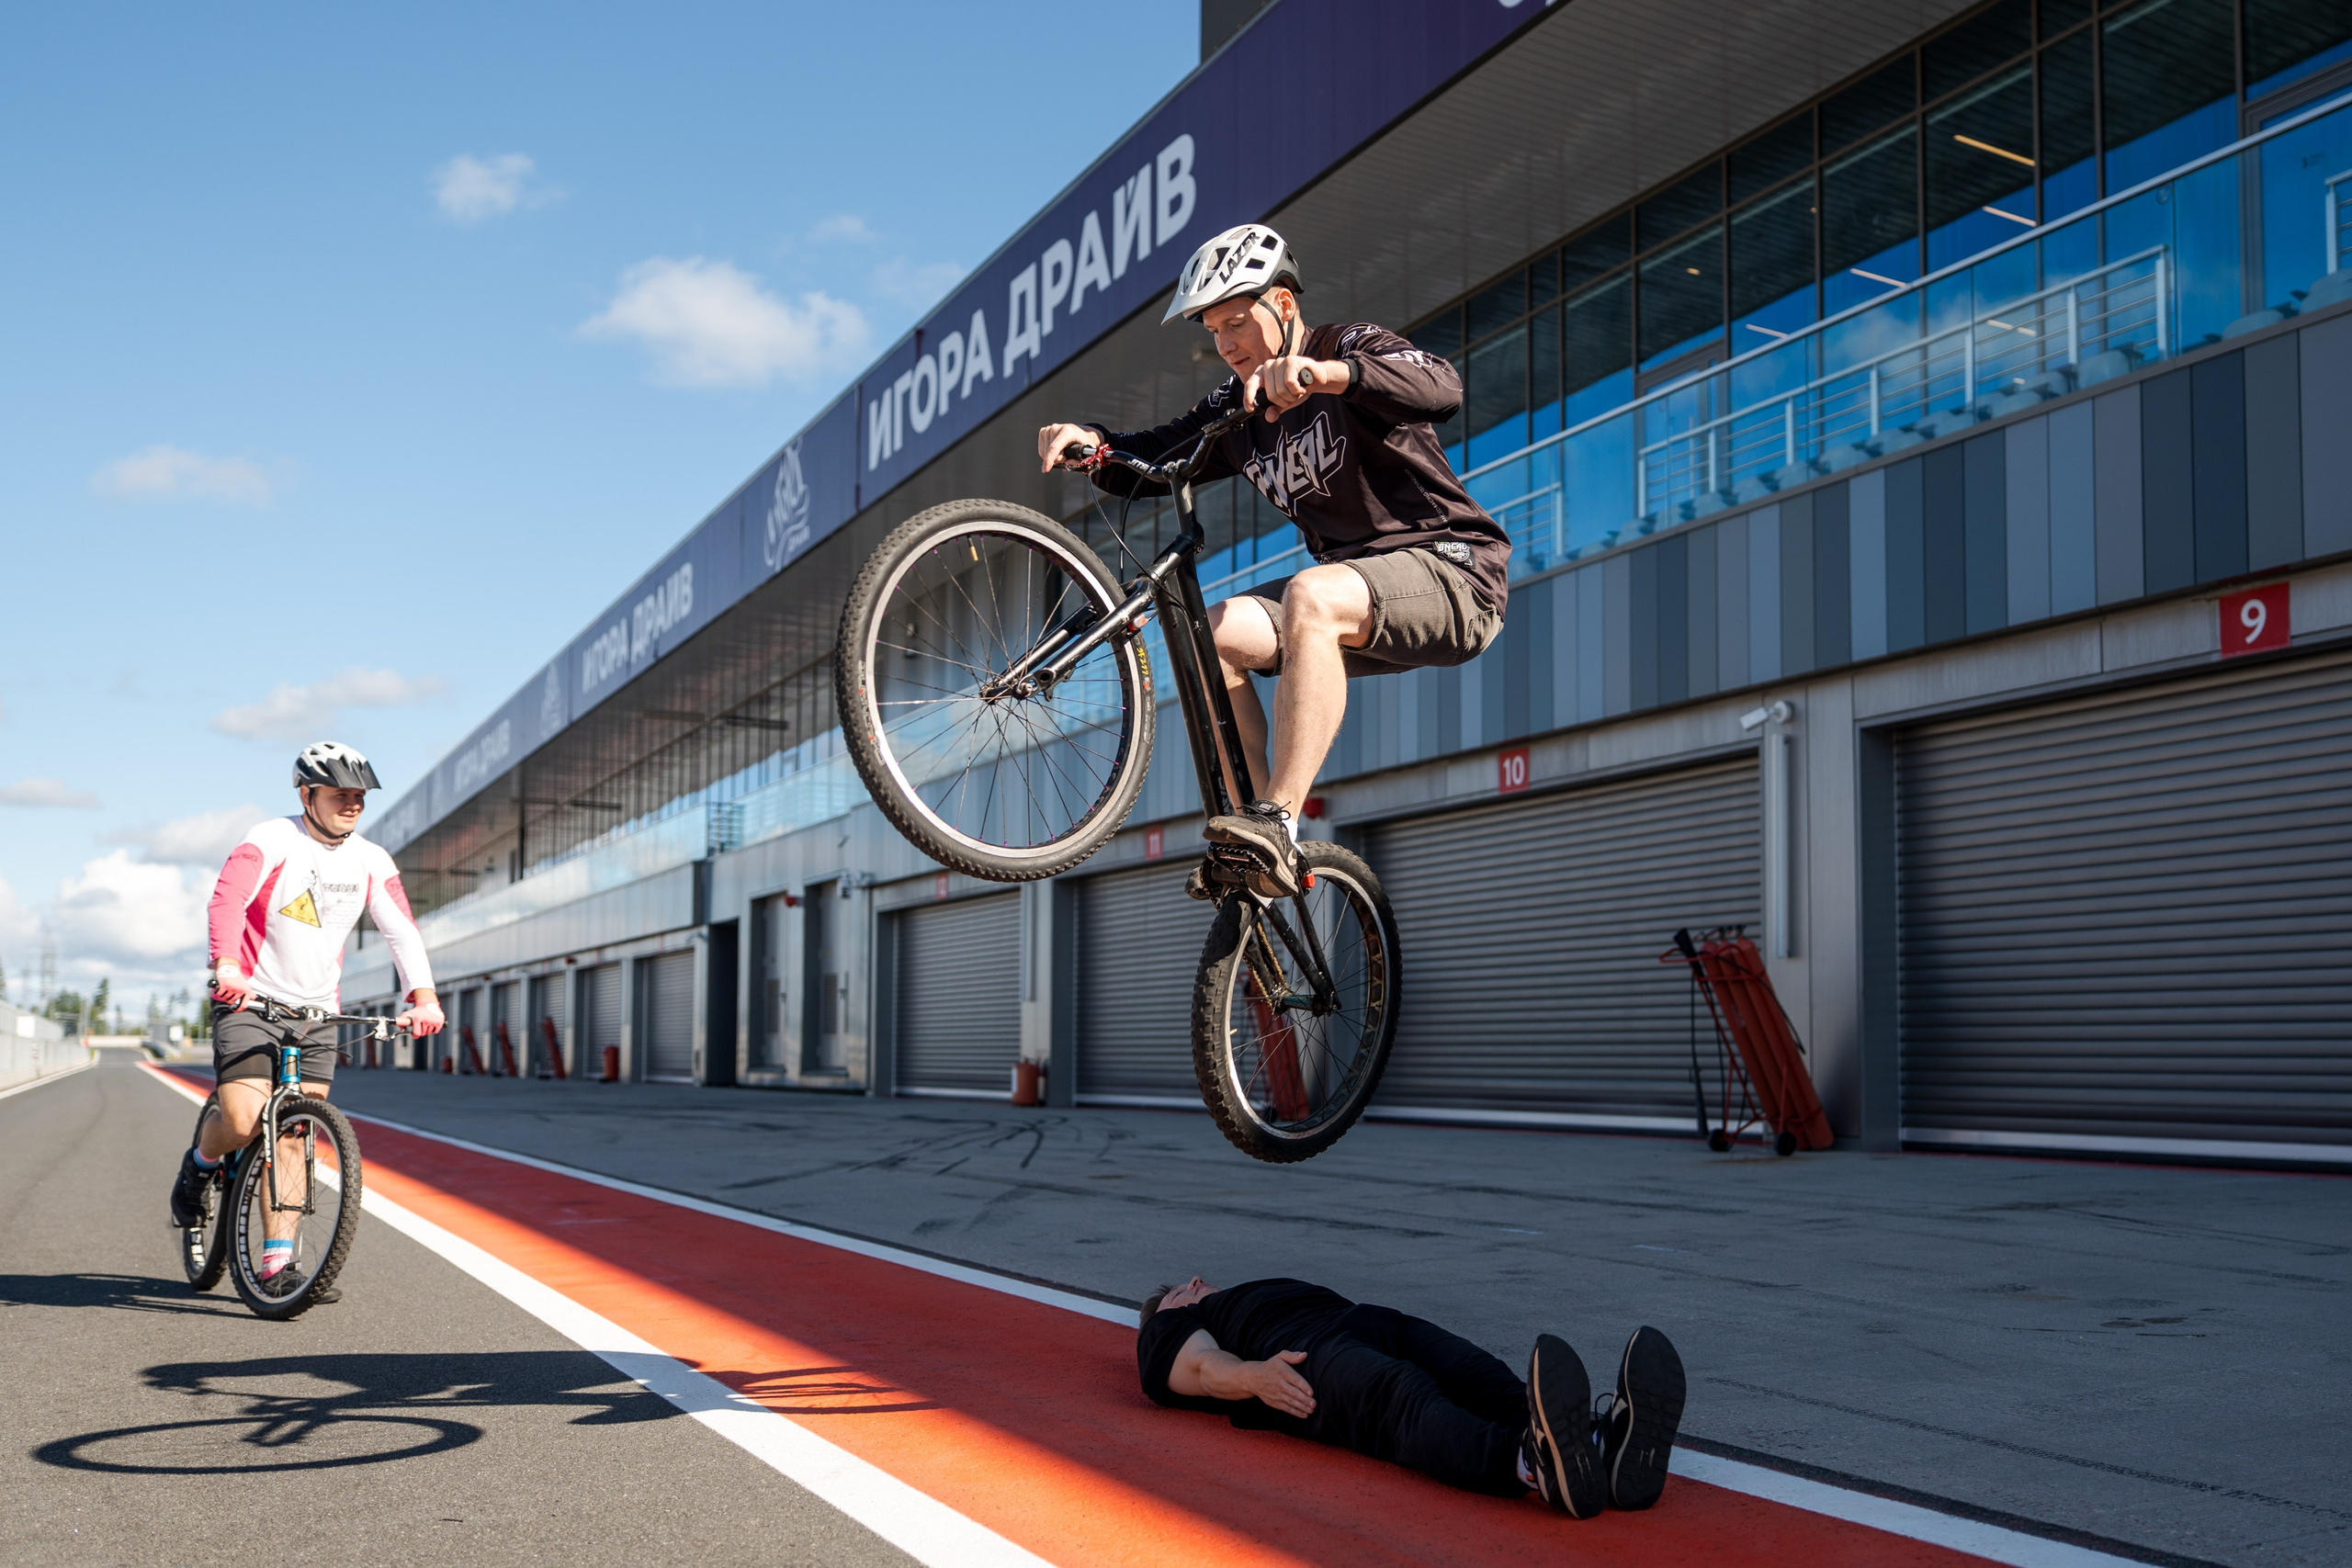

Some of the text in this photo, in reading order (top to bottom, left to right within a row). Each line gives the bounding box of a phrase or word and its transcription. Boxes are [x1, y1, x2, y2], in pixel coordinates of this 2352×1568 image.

[1218, 231, 1261, 285] LAZER
[867, 132, 1196, 472] ИГОРА ДРАЙВ
[2240, 599, 2267, 645] 9
[1502, 755, 1525, 787] 10
